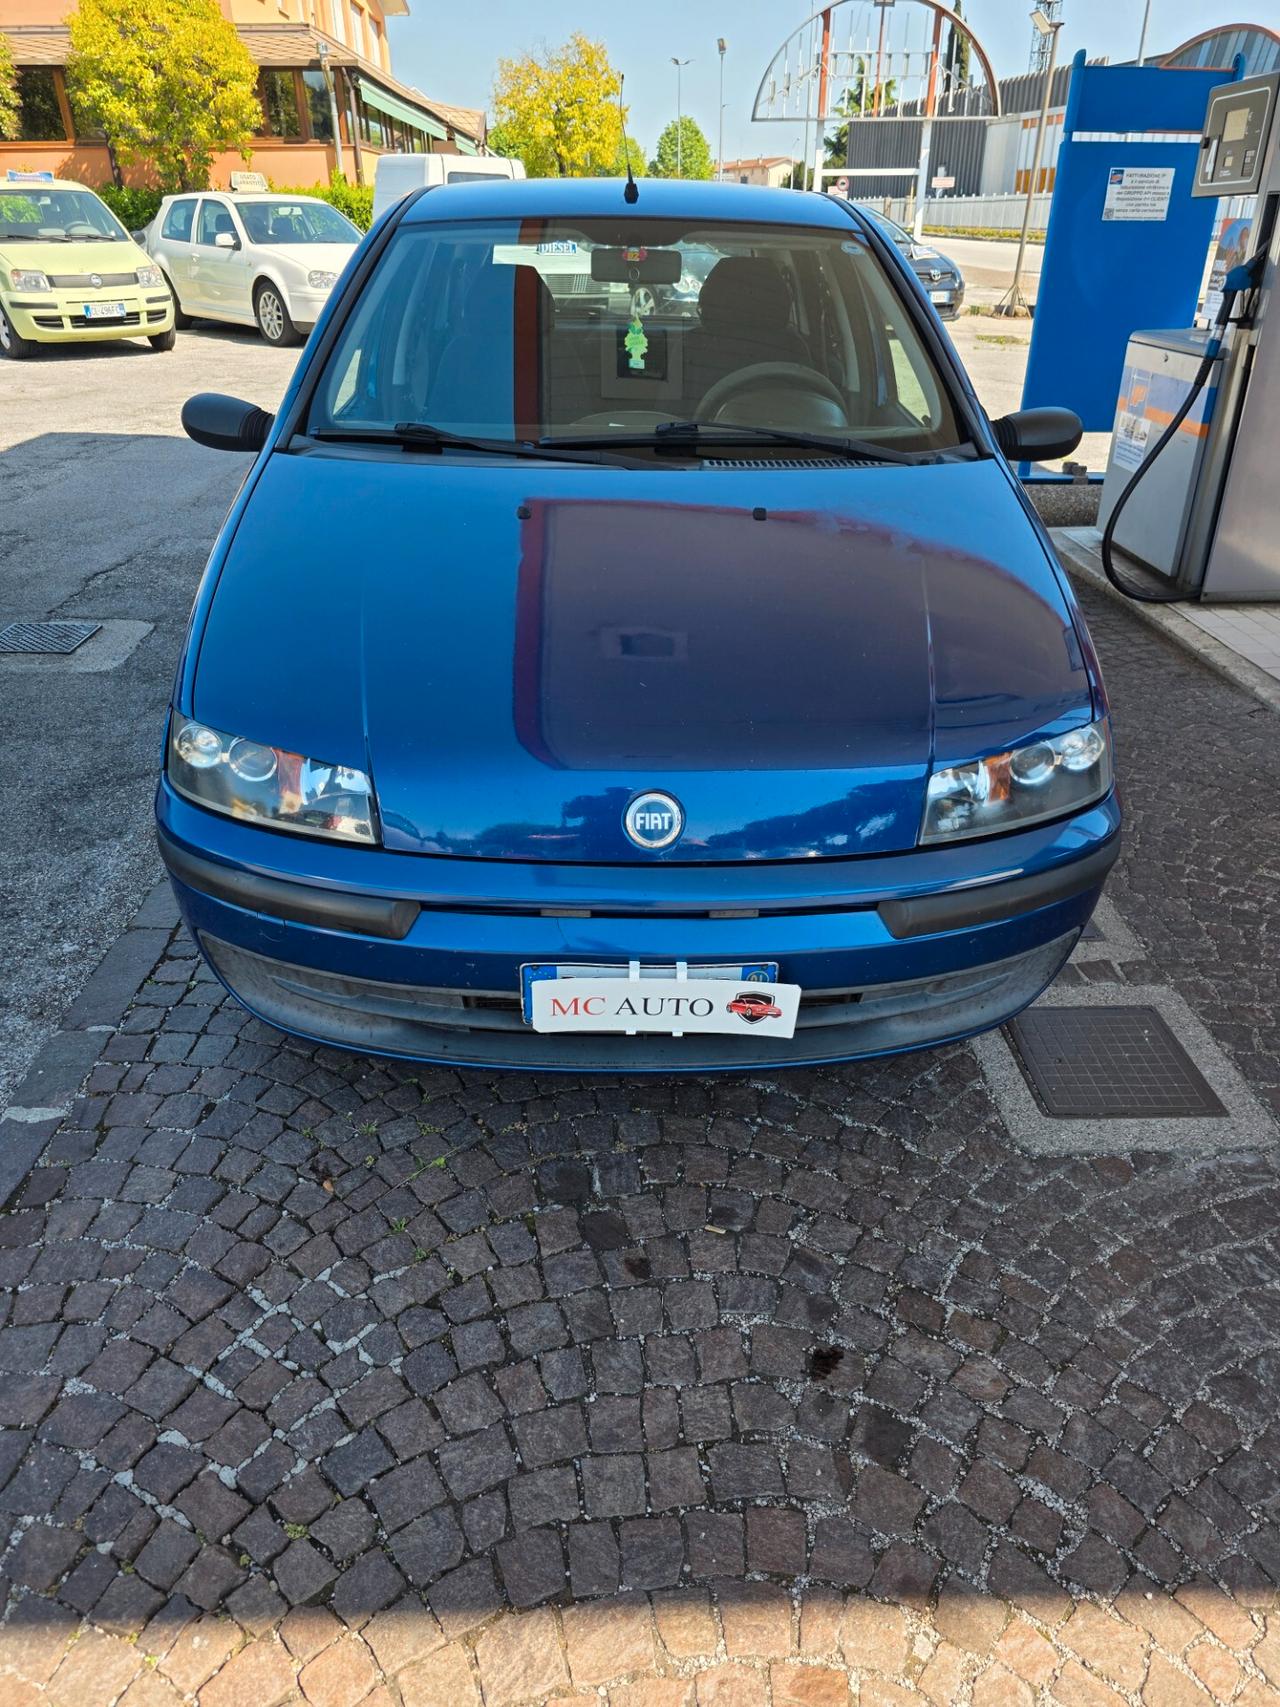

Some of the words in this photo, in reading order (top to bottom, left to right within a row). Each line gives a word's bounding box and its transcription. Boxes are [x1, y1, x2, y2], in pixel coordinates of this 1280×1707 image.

[541, 241, 574, 254] DIESEL
[636, 813, 671, 830] FIAT
[551, 997, 606, 1017] MC
[614, 996, 714, 1017] AUTO
